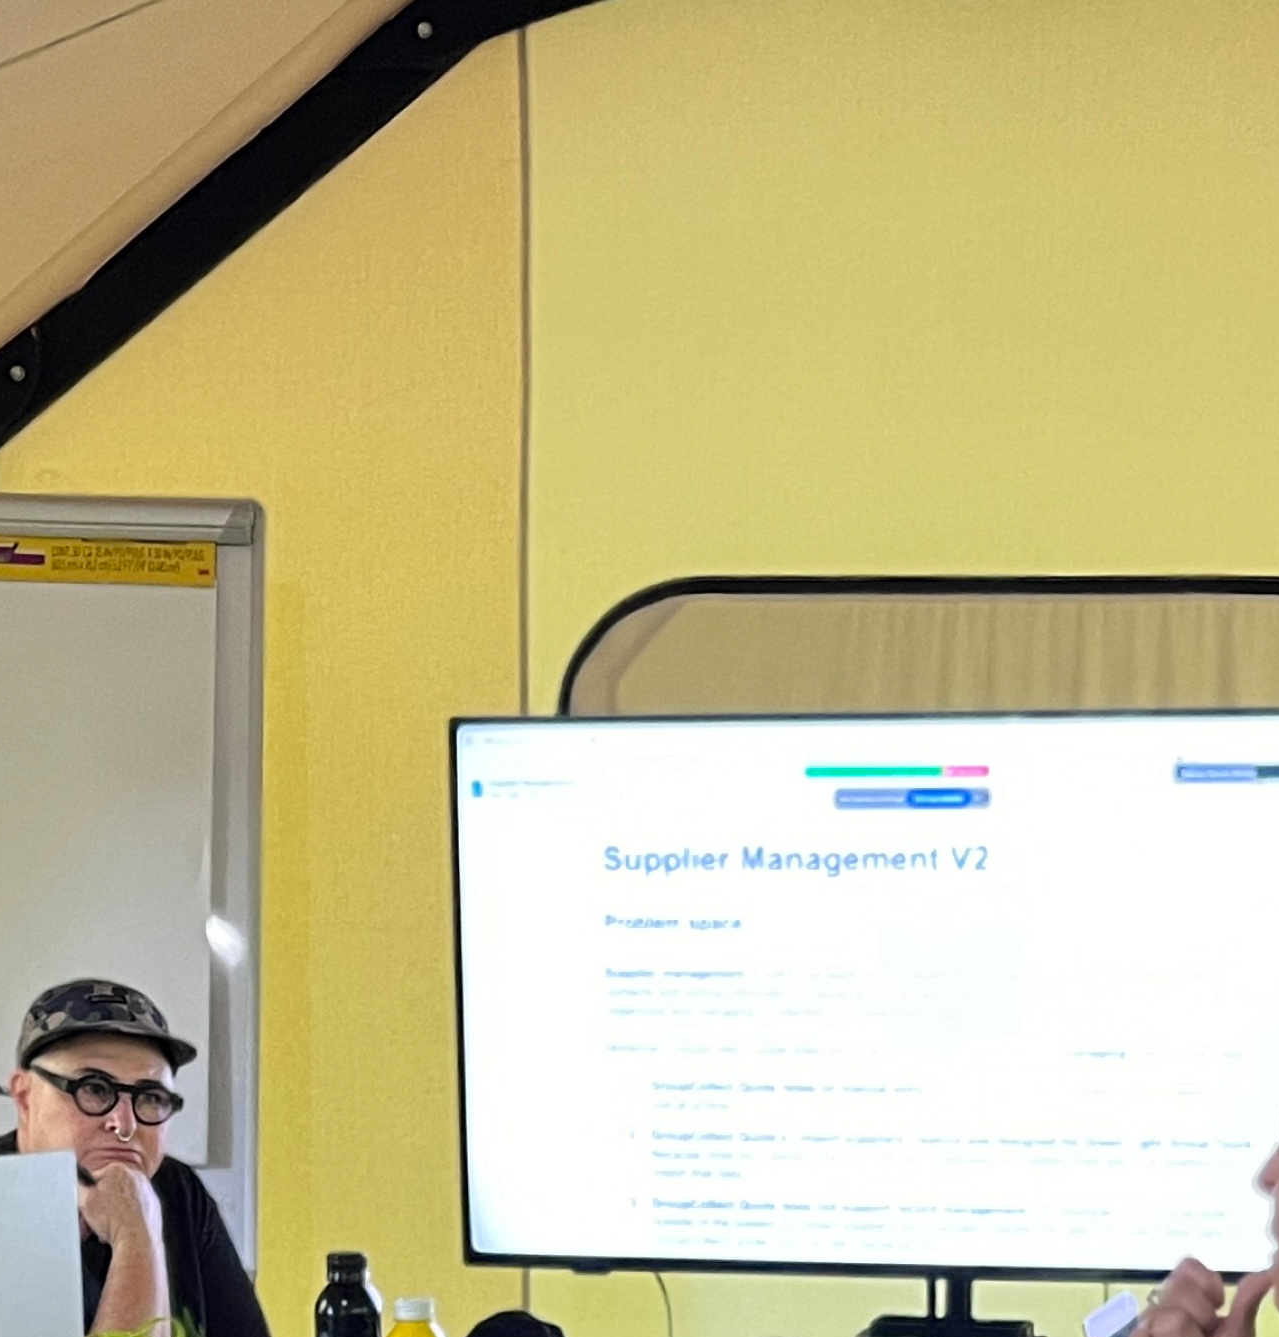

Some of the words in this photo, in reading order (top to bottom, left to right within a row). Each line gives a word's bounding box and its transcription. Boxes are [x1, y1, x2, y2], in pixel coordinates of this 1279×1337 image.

[604, 846, 729, 877] Supplier
[742, 846, 938, 878] Management
[951, 845, 989, 871] V2
